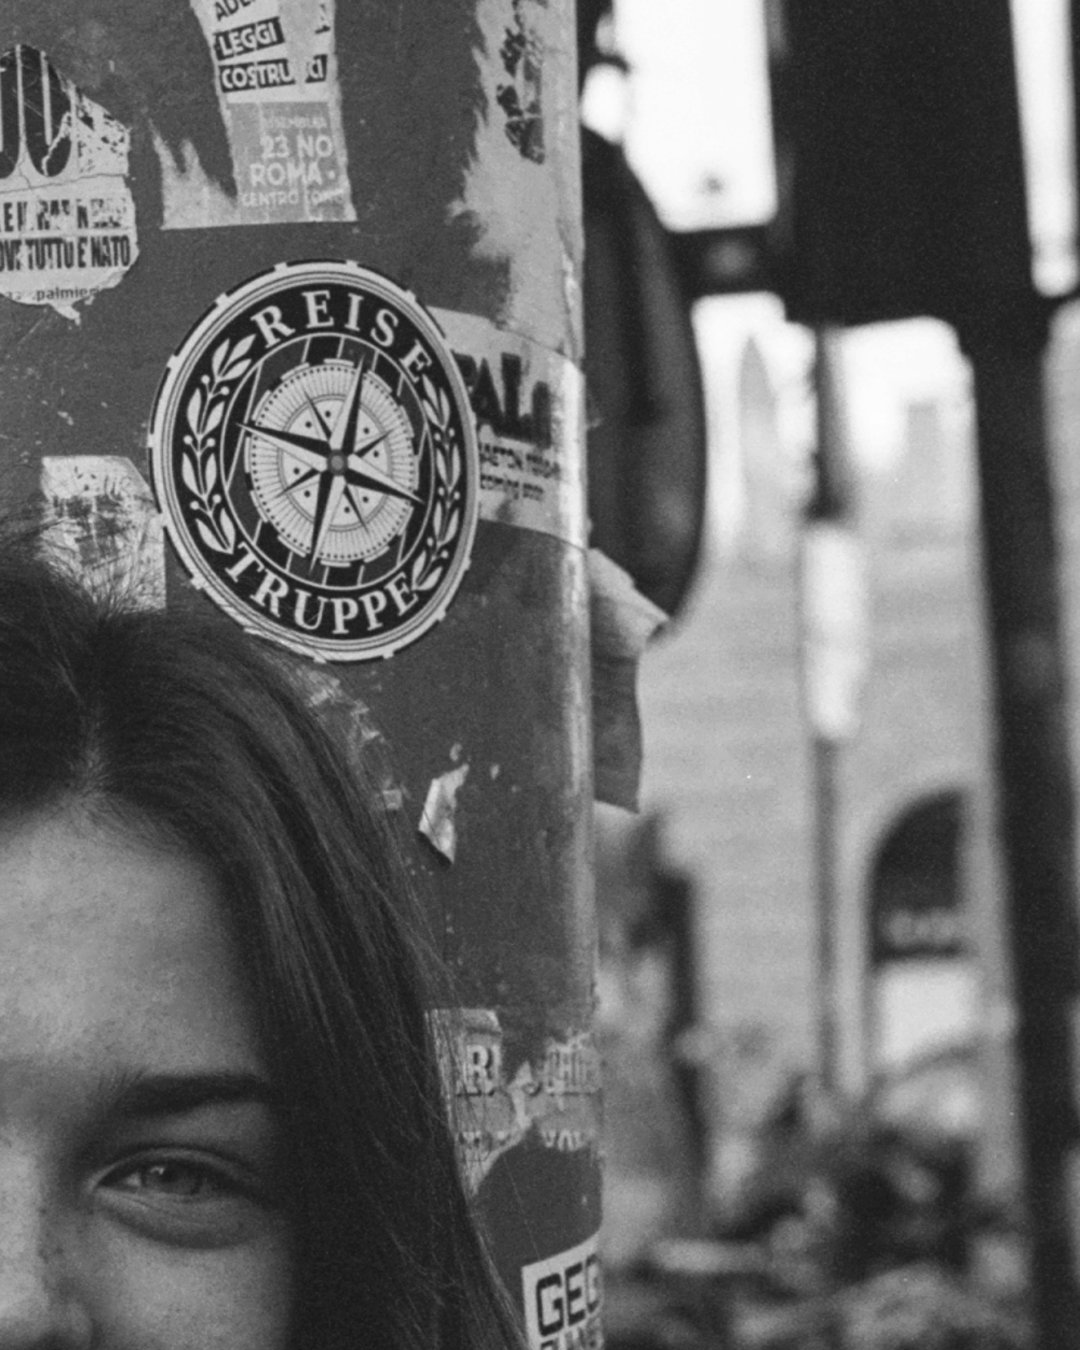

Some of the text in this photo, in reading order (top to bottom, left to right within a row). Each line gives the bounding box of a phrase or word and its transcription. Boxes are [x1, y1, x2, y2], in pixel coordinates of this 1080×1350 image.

[218, 21, 278, 57] LEGGI
[221, 57, 324, 89] COSTRUCI
[249, 160, 323, 187] ROMA
[242, 190, 299, 207] CENTRO
[25, 236, 75, 270] TUTTO
[90, 234, 131, 268] NATO
[250, 289, 434, 385] REISE
[224, 541, 419, 635] TRUPPE
